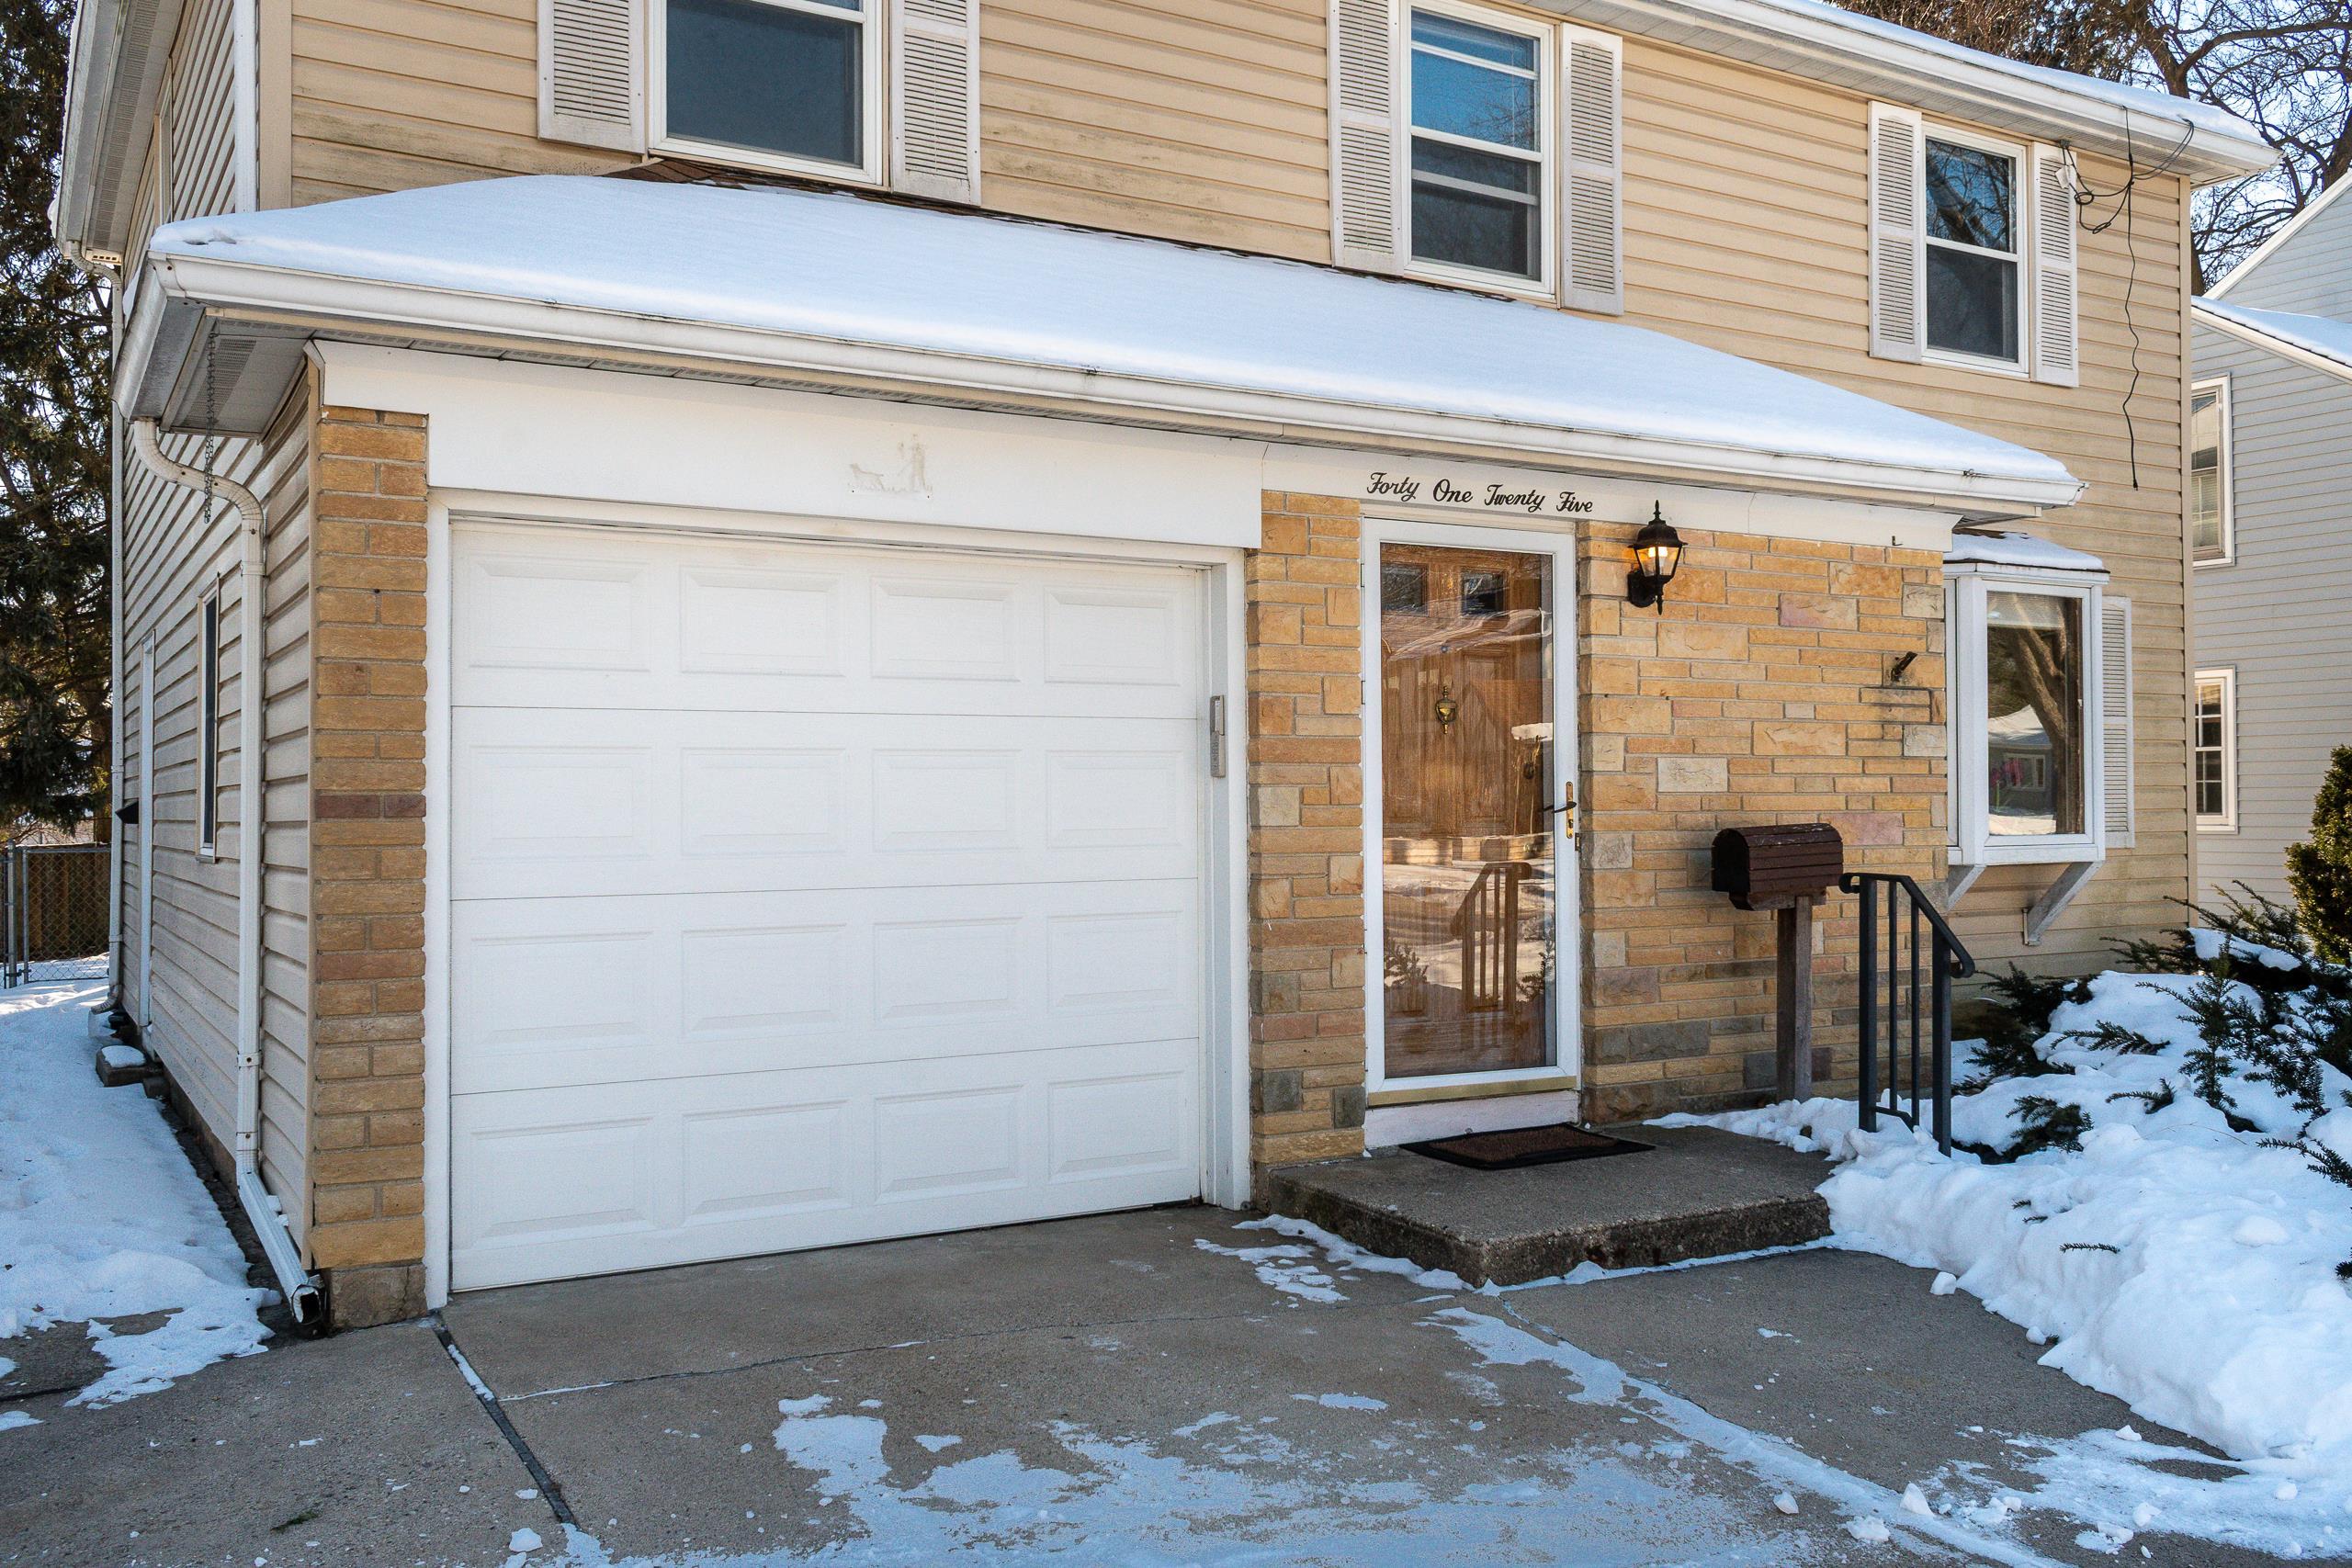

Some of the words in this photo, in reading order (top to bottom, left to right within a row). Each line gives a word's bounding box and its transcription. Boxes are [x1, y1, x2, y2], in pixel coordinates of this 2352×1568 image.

[1366, 471, 1420, 502] Forty
[1432, 478, 1474, 503] One
[1484, 483, 1546, 513] Twenty
[1555, 491, 1593, 513] Five
